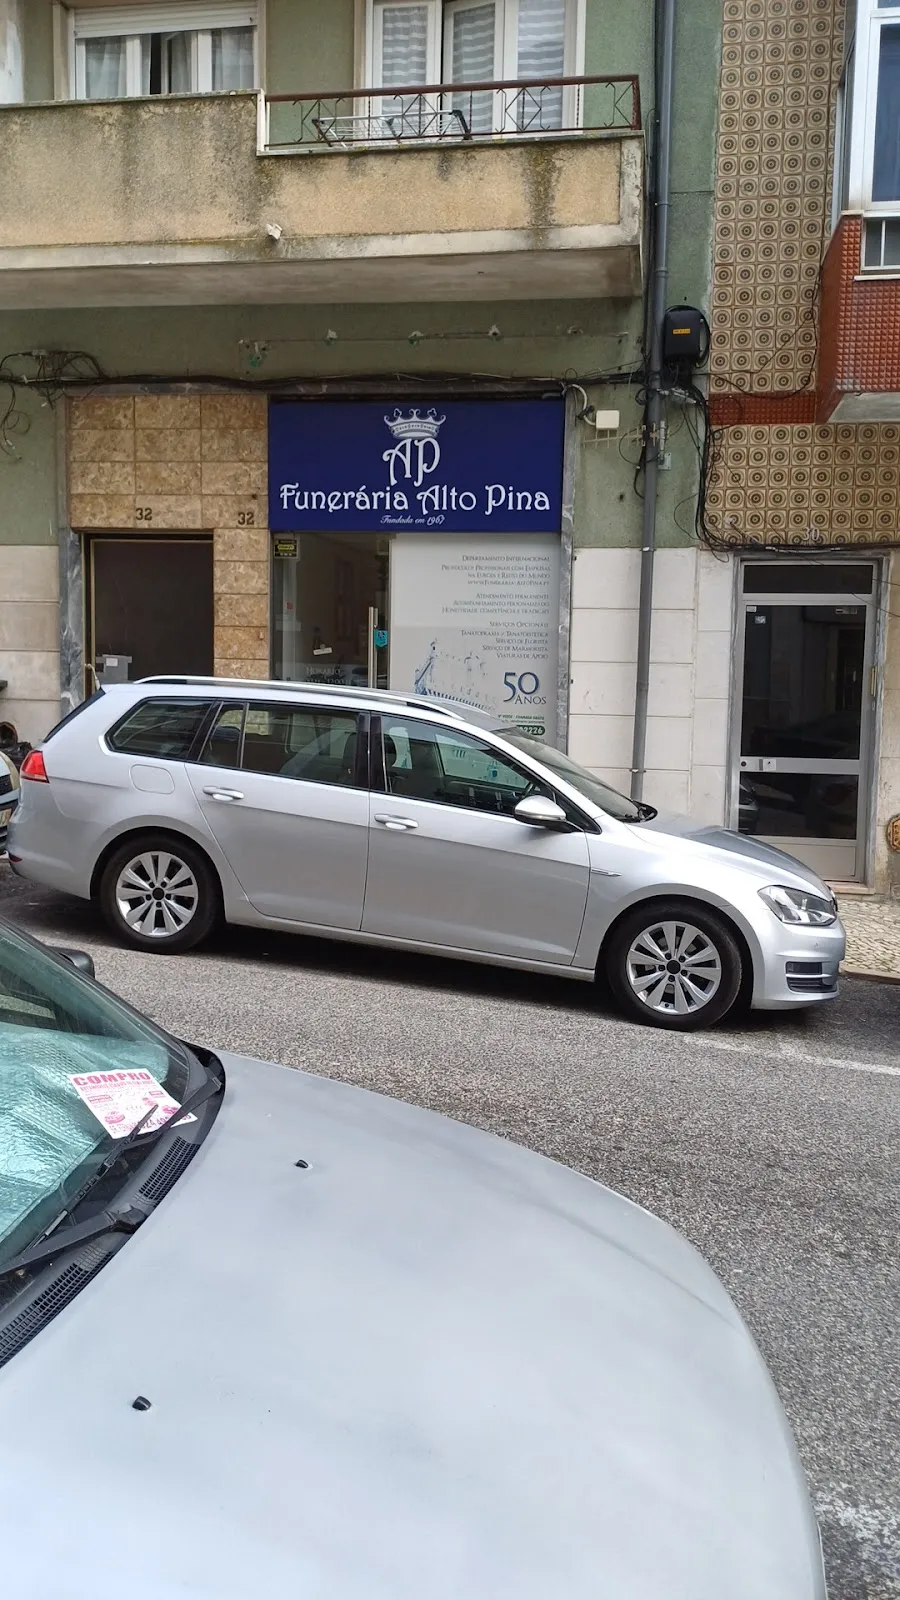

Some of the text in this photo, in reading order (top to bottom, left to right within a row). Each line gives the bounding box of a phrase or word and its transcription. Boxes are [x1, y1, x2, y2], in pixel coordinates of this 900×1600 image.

[382, 438, 440, 487] AP
[280, 483, 550, 516] Funerária Alto Pina
[135, 507, 153, 521] 32
[237, 511, 255, 526] 32
[380, 515, 414, 525] Fundada
[426, 514, 446, 526] 1967
[801, 526, 820, 541] 30
[503, 671, 540, 703] 50
[514, 694, 547, 705] ANOS
[72, 1071, 151, 1086] COMPRO
